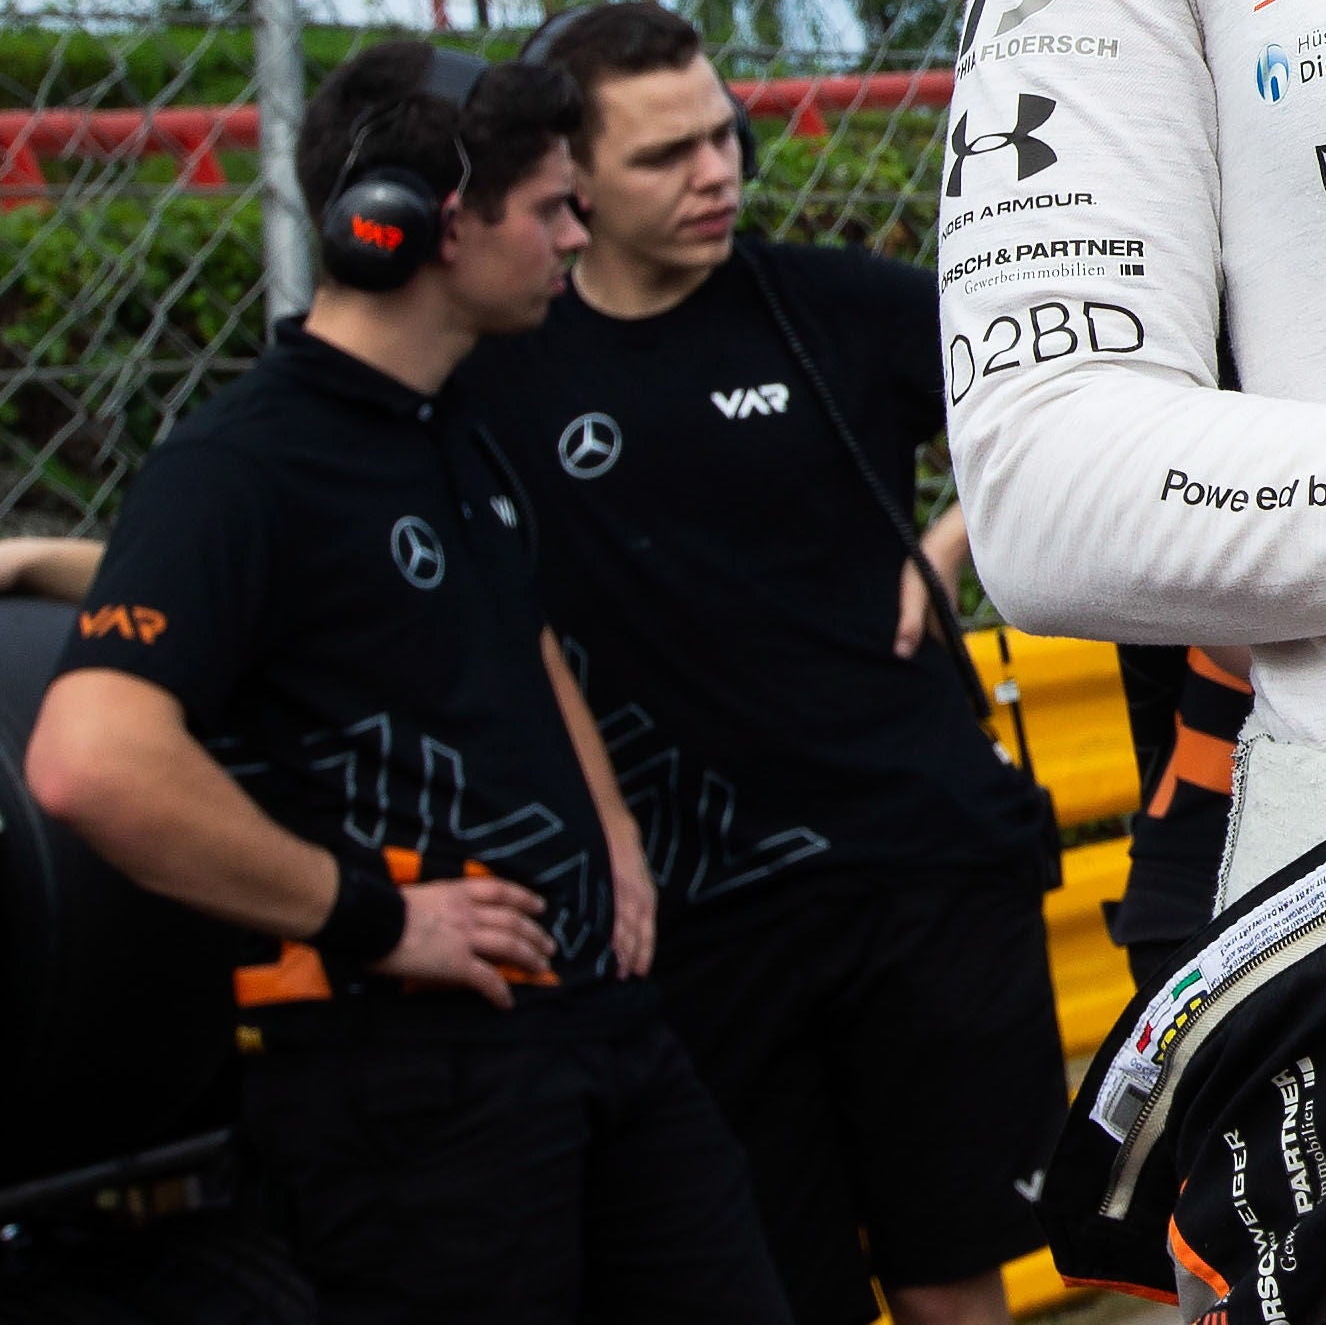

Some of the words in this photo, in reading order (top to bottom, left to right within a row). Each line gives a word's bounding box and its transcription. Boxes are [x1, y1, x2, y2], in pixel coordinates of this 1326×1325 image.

[980, 35, 1119, 62] FLOERSCH
[994, 248, 1012, 265] &
[1016, 239, 1145, 262] PARTNER
[964, 262, 1105, 296] Gewerbeimmobilien
[710, 382, 790, 420] VAR
[1160, 468, 1299, 512] Poweed
[1271, 1067, 1316, 1216] PARTNER
